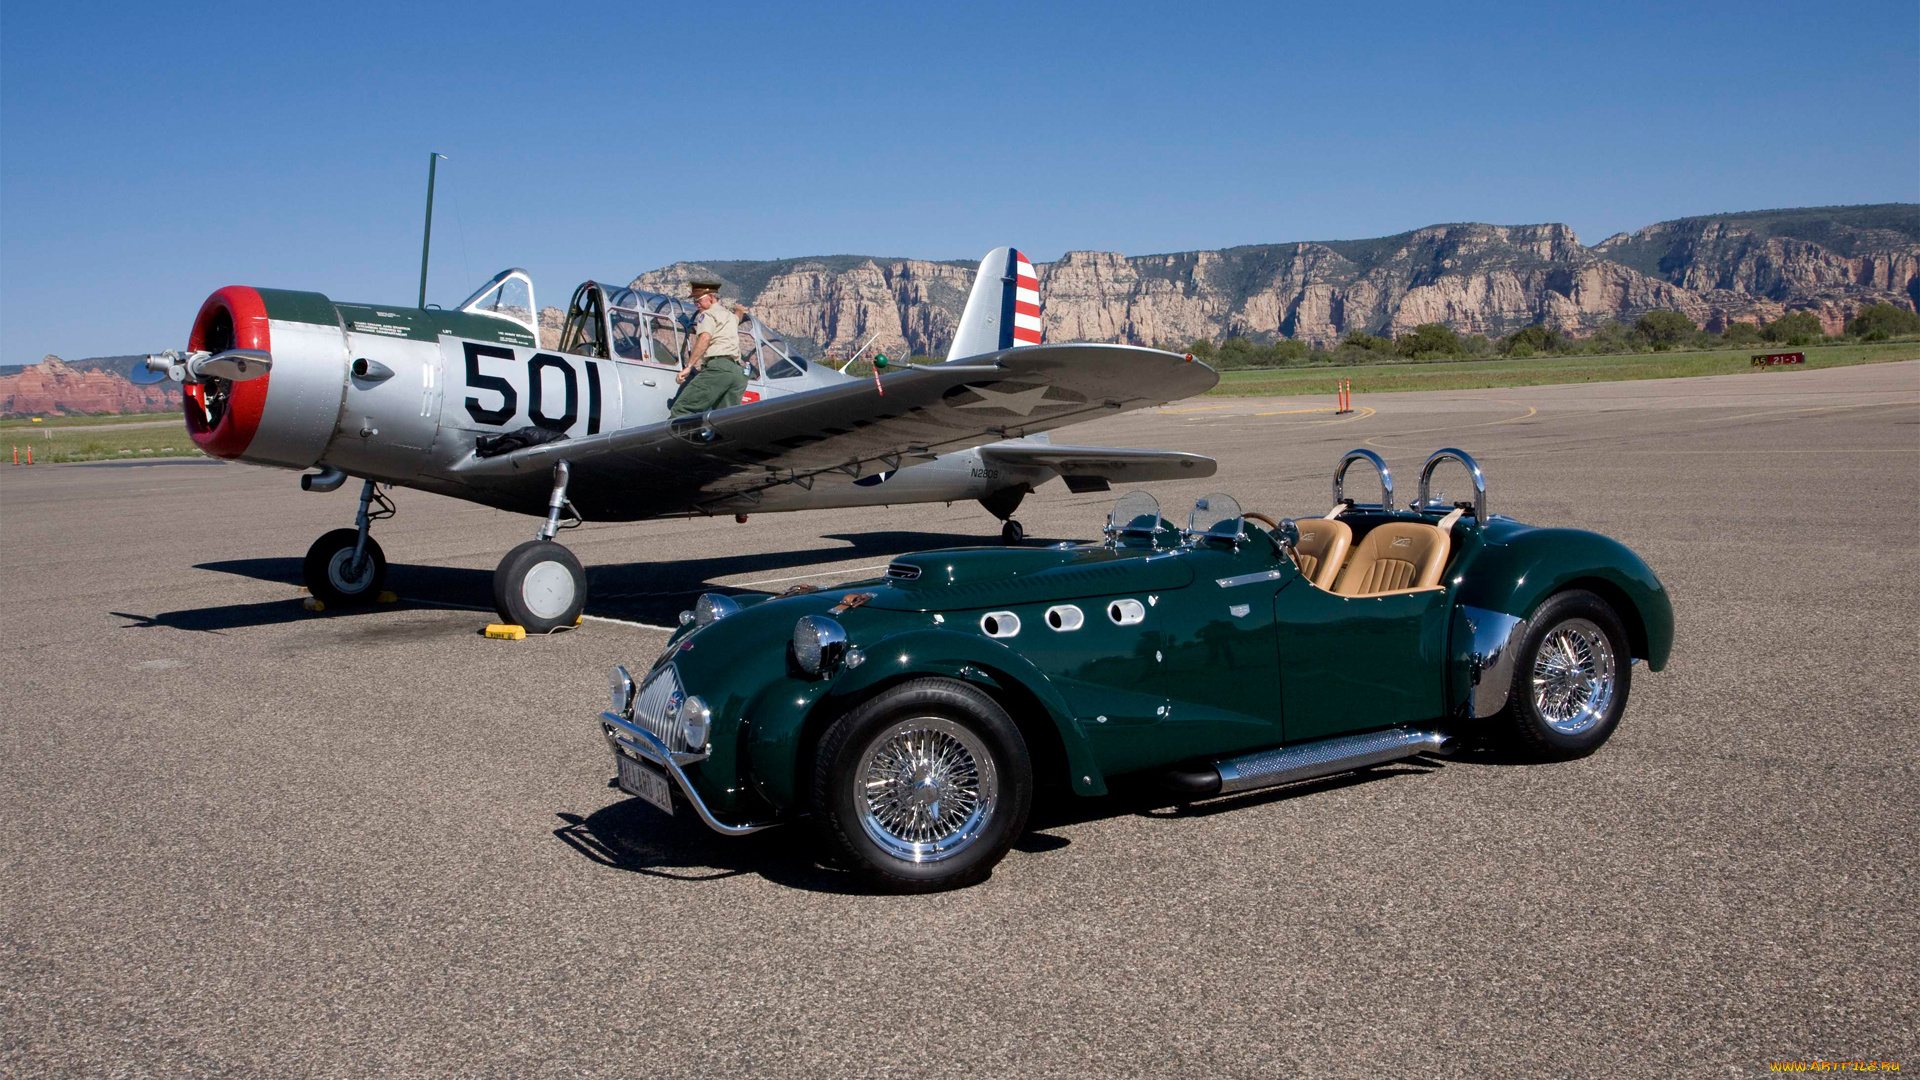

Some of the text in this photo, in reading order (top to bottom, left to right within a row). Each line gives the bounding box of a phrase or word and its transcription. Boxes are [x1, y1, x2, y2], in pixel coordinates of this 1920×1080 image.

[1754, 357, 1766, 366] A5
[462, 341, 602, 436] 501
[970, 468, 999, 479] N2808
